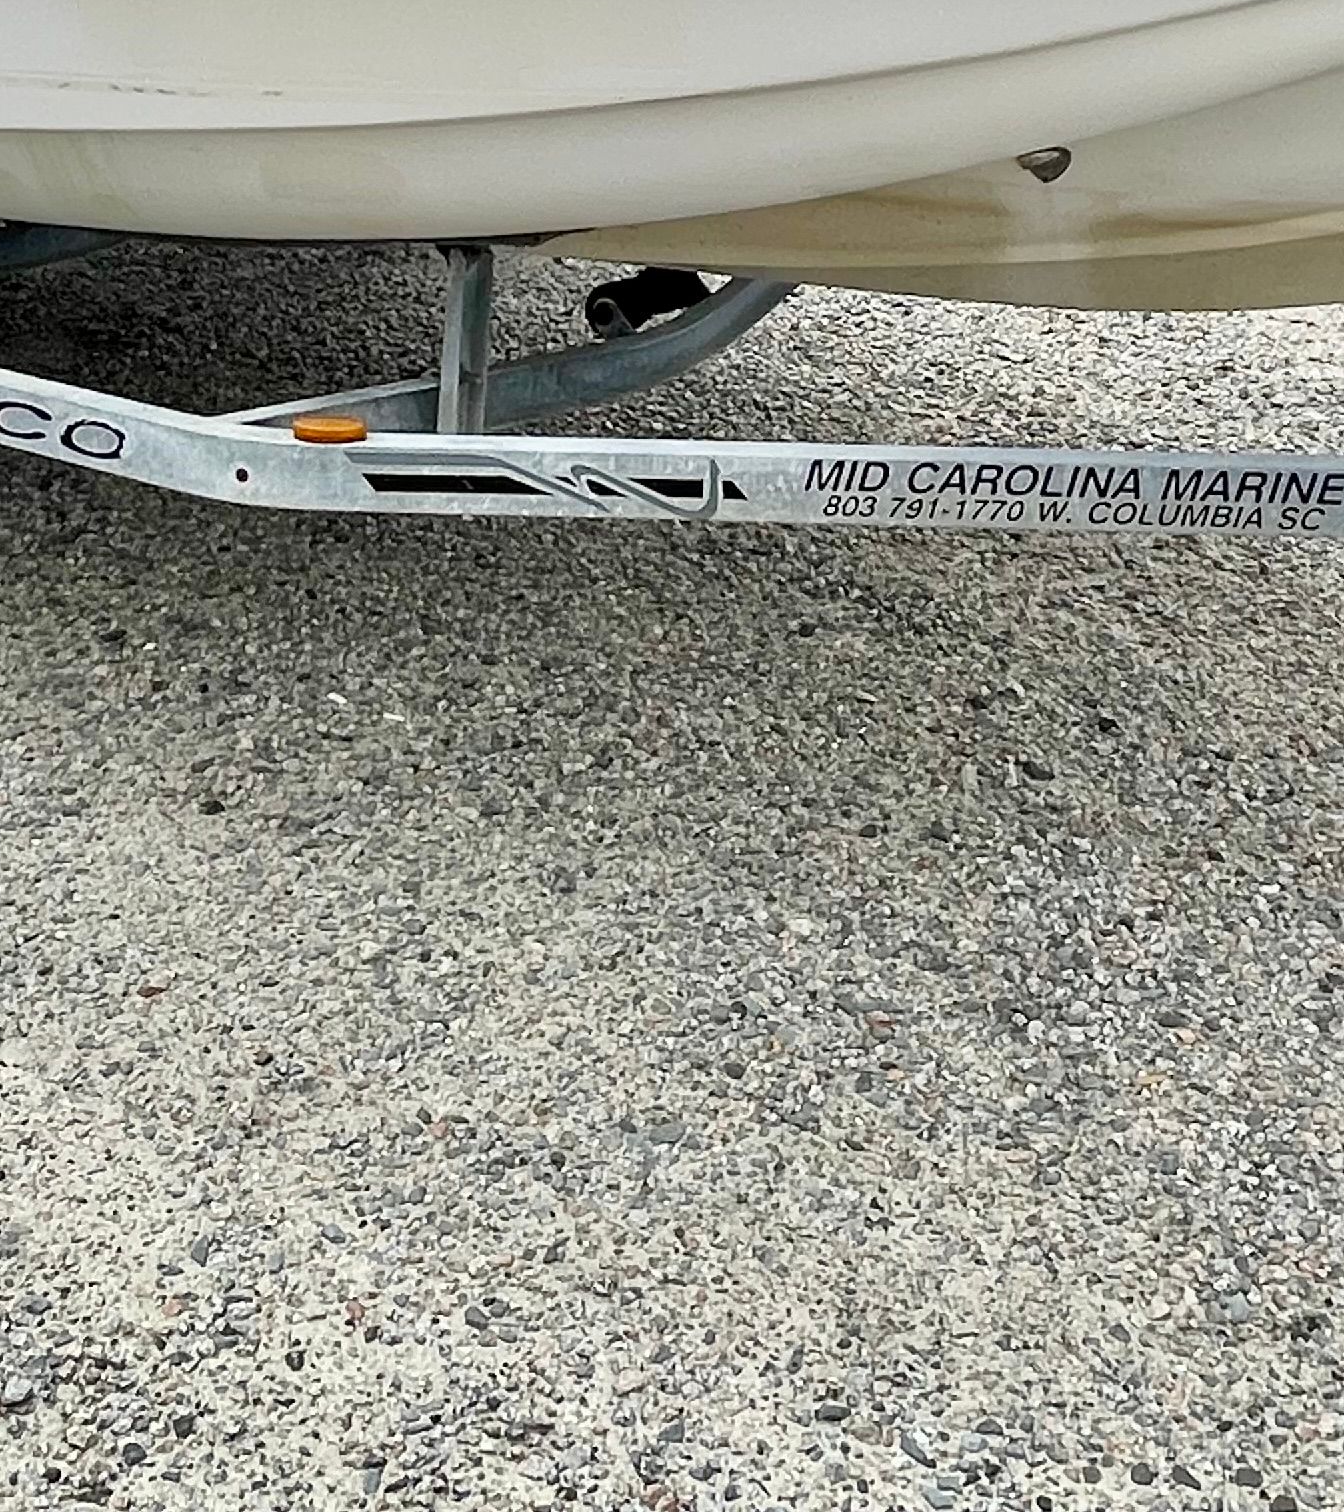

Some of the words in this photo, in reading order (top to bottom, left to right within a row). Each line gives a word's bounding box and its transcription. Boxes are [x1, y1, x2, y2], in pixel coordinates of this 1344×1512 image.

[804, 459, 890, 491] MID
[908, 462, 1141, 500] CAROLINA
[822, 494, 878, 517] 803
[888, 496, 1025, 522] 791-1770
[1039, 500, 1072, 524] W.
[1088, 501, 1263, 530] COLUMBIA
[1277, 506, 1326, 530] SC
